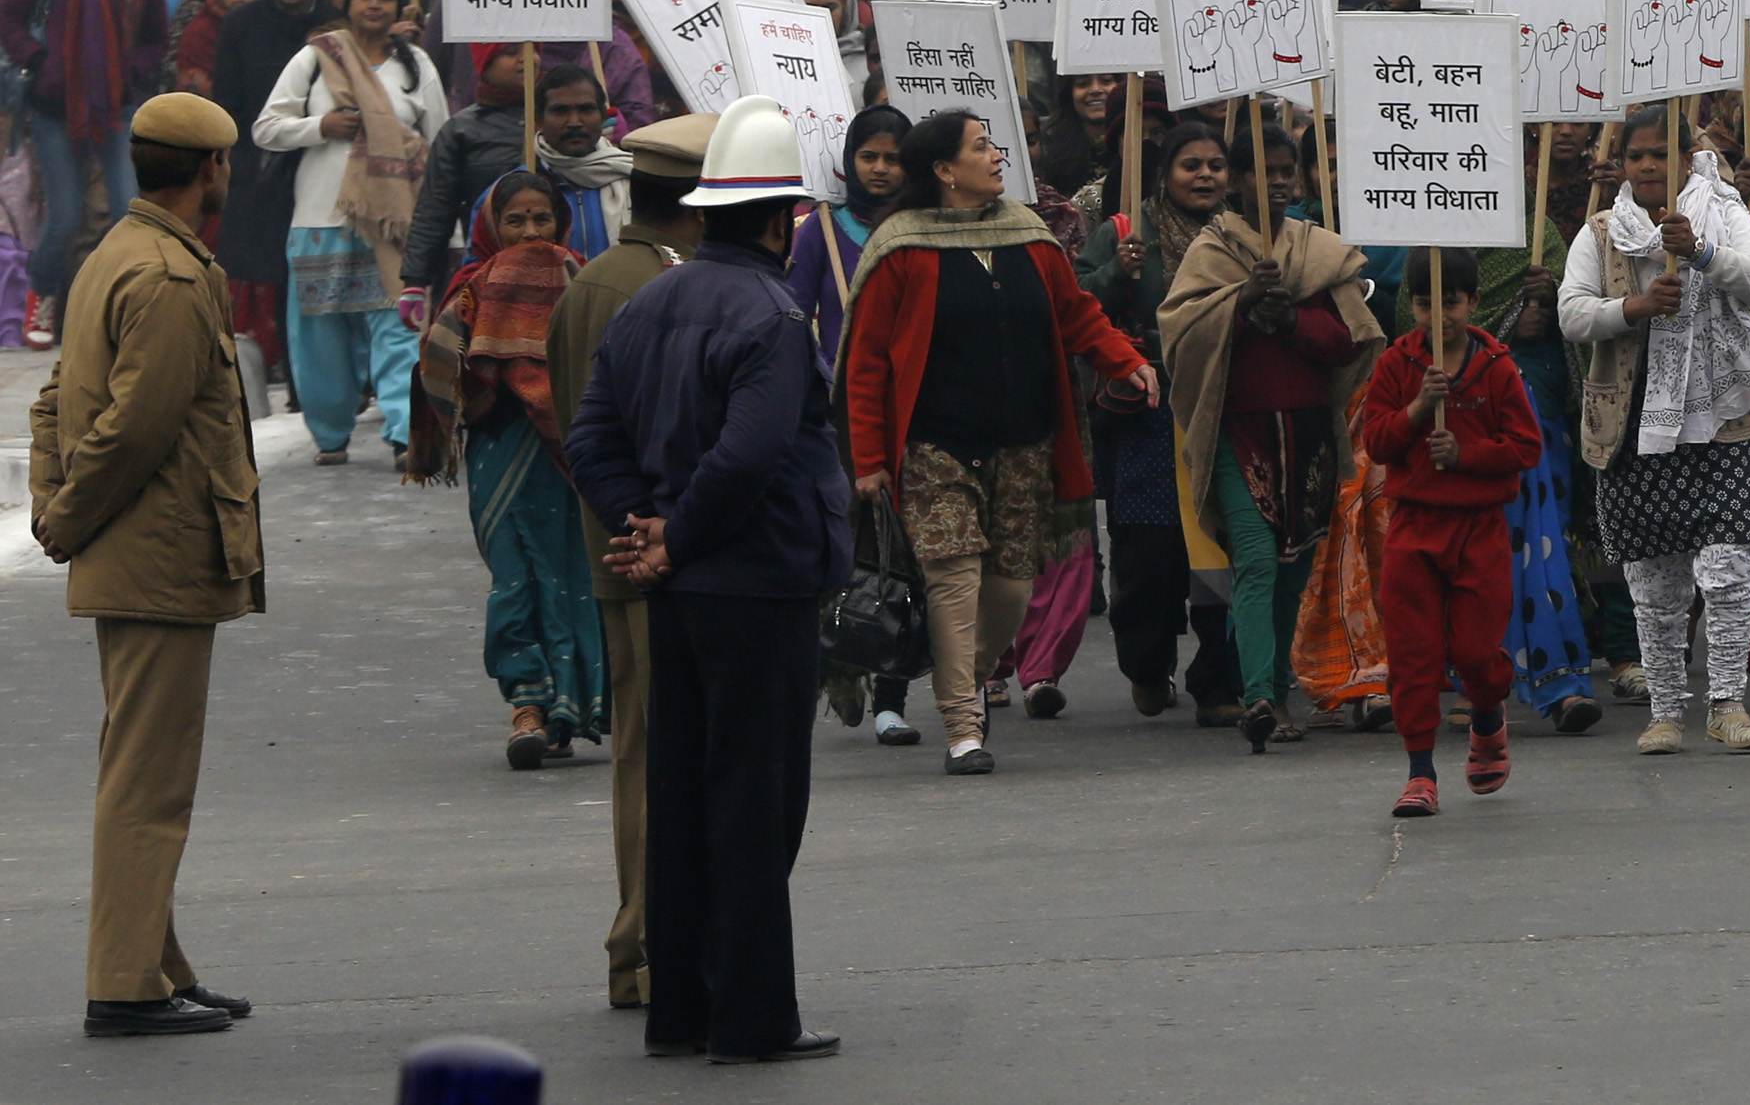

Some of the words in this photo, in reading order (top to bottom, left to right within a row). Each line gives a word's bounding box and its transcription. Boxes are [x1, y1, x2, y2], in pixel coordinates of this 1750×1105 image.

[760, 23, 777, 37] हमें
[779, 23, 813, 45] चाहिए
[773, 54, 817, 81] न्याय
[906, 41, 942, 67] हिंसा
[947, 43, 974, 69] नहीं
[1374, 55, 1422, 86] बेटी,
[1433, 65, 1482, 87] बहन
[896, 77, 946, 94] सम्मान
[951, 73, 996, 100] चाहिए
[1378, 103, 1418, 129] बहू,
[1428, 103, 1479, 123] माता
[1373, 145, 1448, 171] परिवार
[1457, 144, 1487, 172] की
[1364, 190, 1416, 209] भाग्य
[1424, 183, 1498, 210] विधाता
